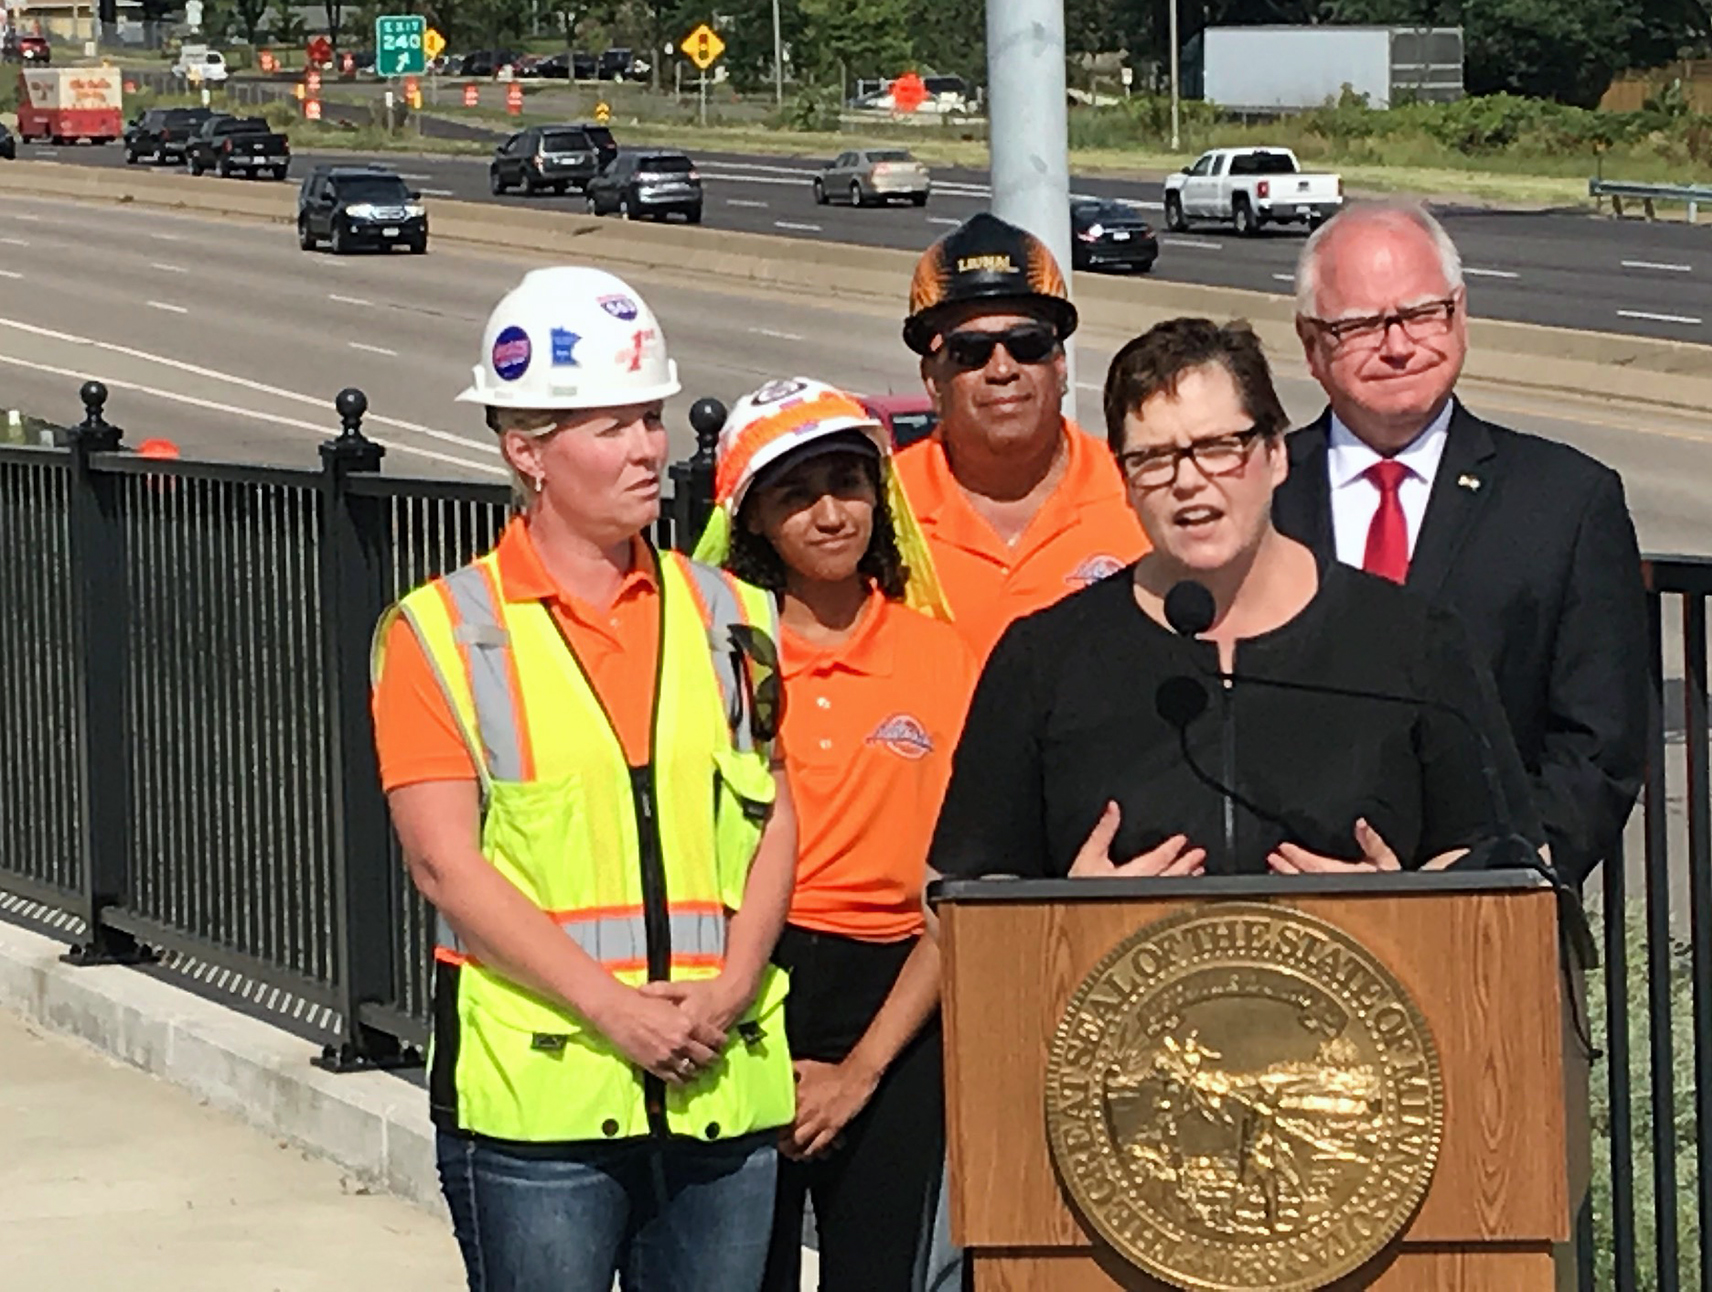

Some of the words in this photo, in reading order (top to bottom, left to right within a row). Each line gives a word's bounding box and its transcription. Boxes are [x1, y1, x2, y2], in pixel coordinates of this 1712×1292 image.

[383, 33, 421, 51] 240
[384, 21, 419, 33] EXIT
[1134, 932, 1183, 979] OF
[1182, 919, 1271, 952] THE
[1275, 922, 1391, 1010] STATE
[1066, 965, 1138, 1068] SEAL
[1373, 1001, 1417, 1054] OF
[1060, 1073, 1120, 1203] GREAT
